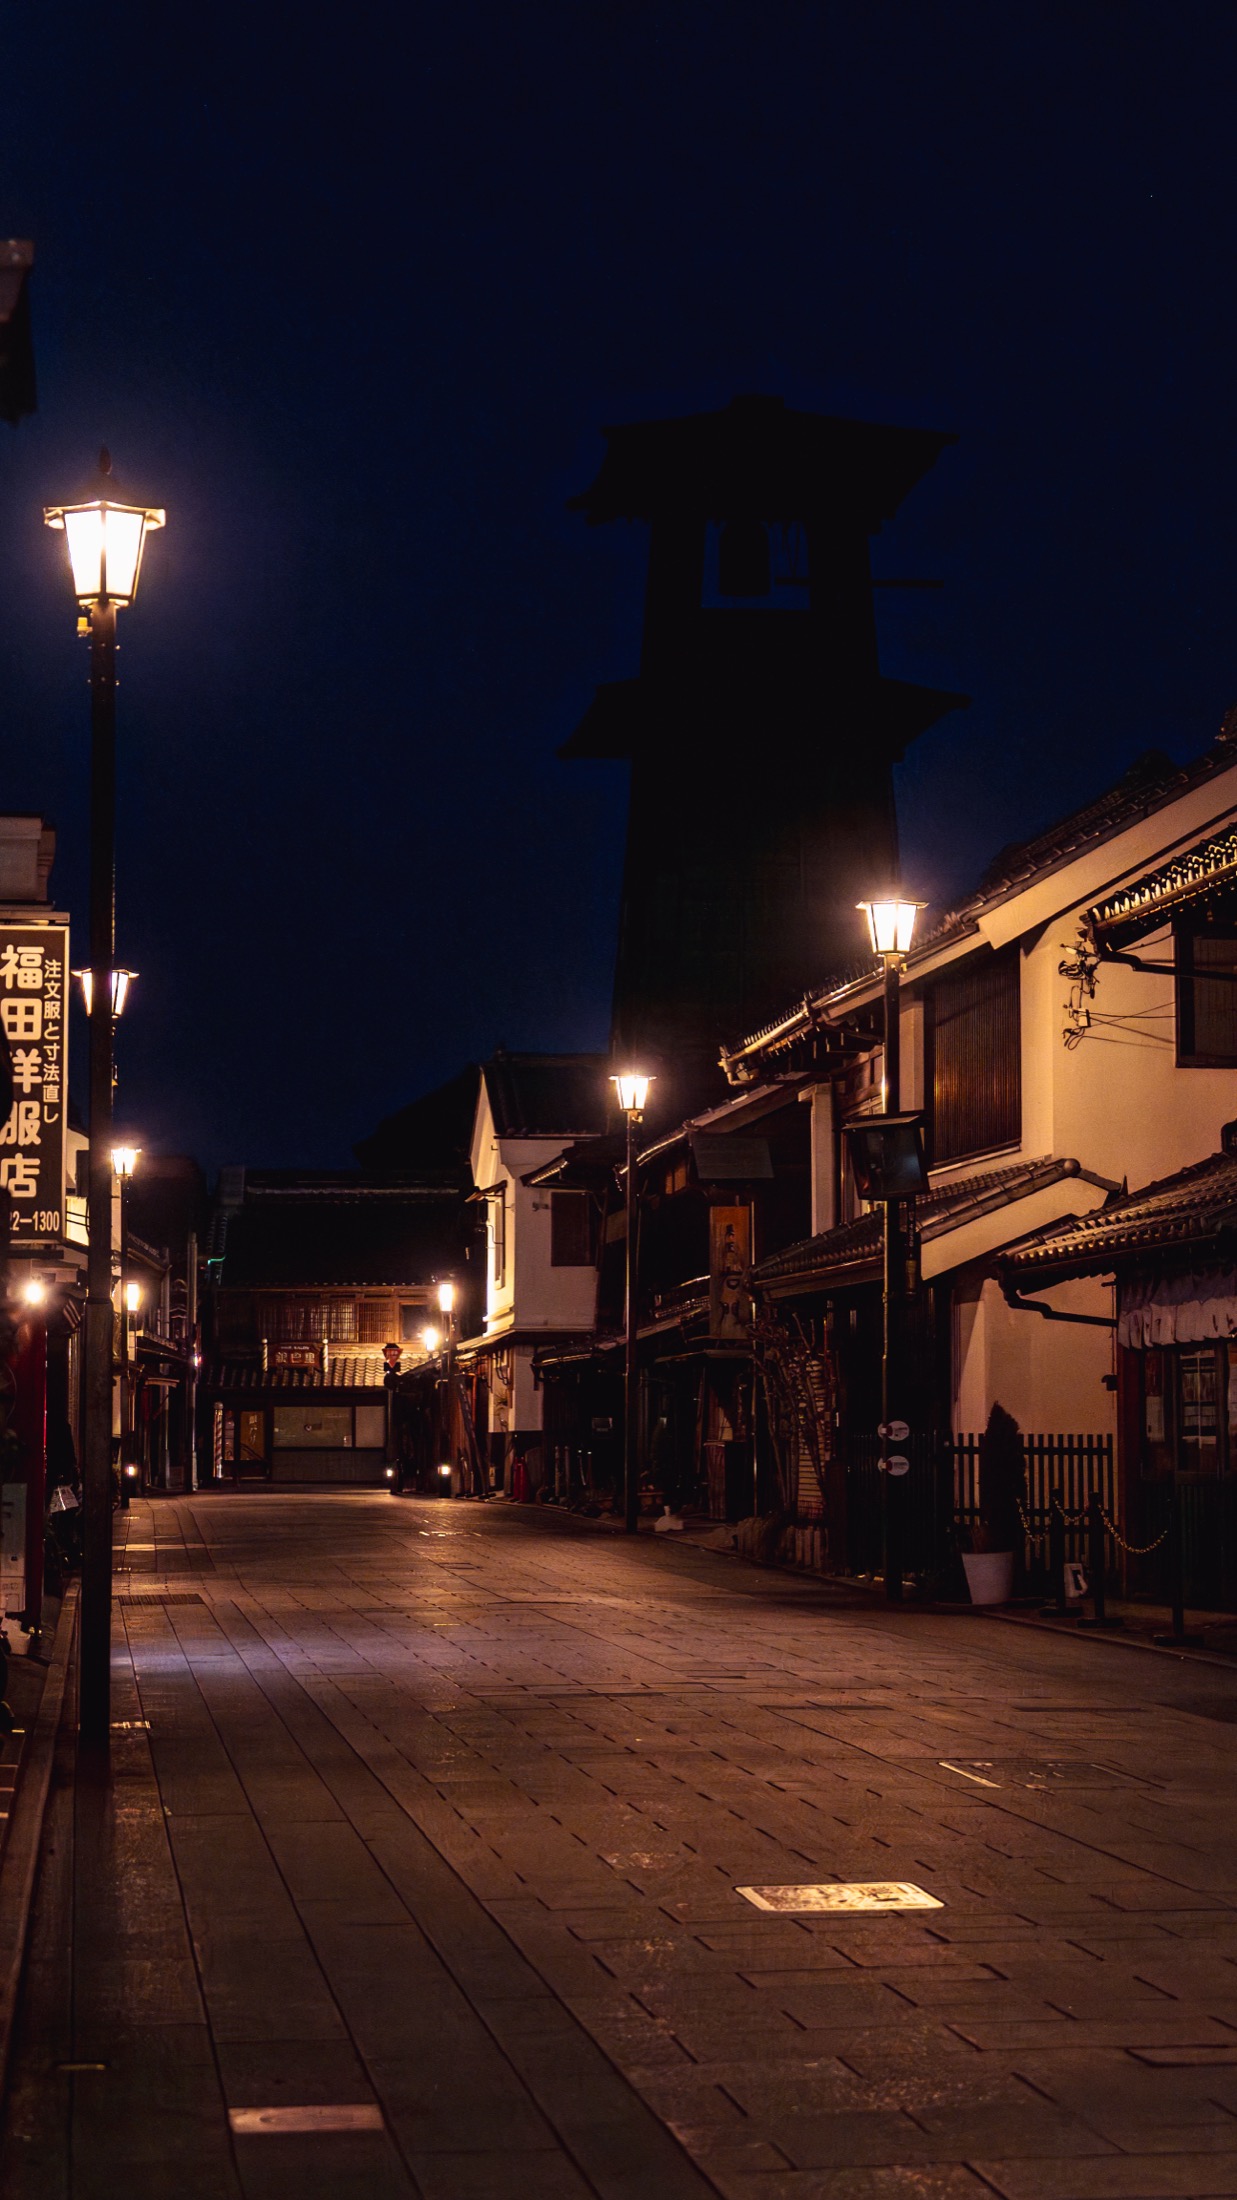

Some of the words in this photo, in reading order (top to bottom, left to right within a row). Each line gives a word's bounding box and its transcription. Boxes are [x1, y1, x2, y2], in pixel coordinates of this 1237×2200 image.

[42, 959, 62, 1124] 注文服と寸法直し
